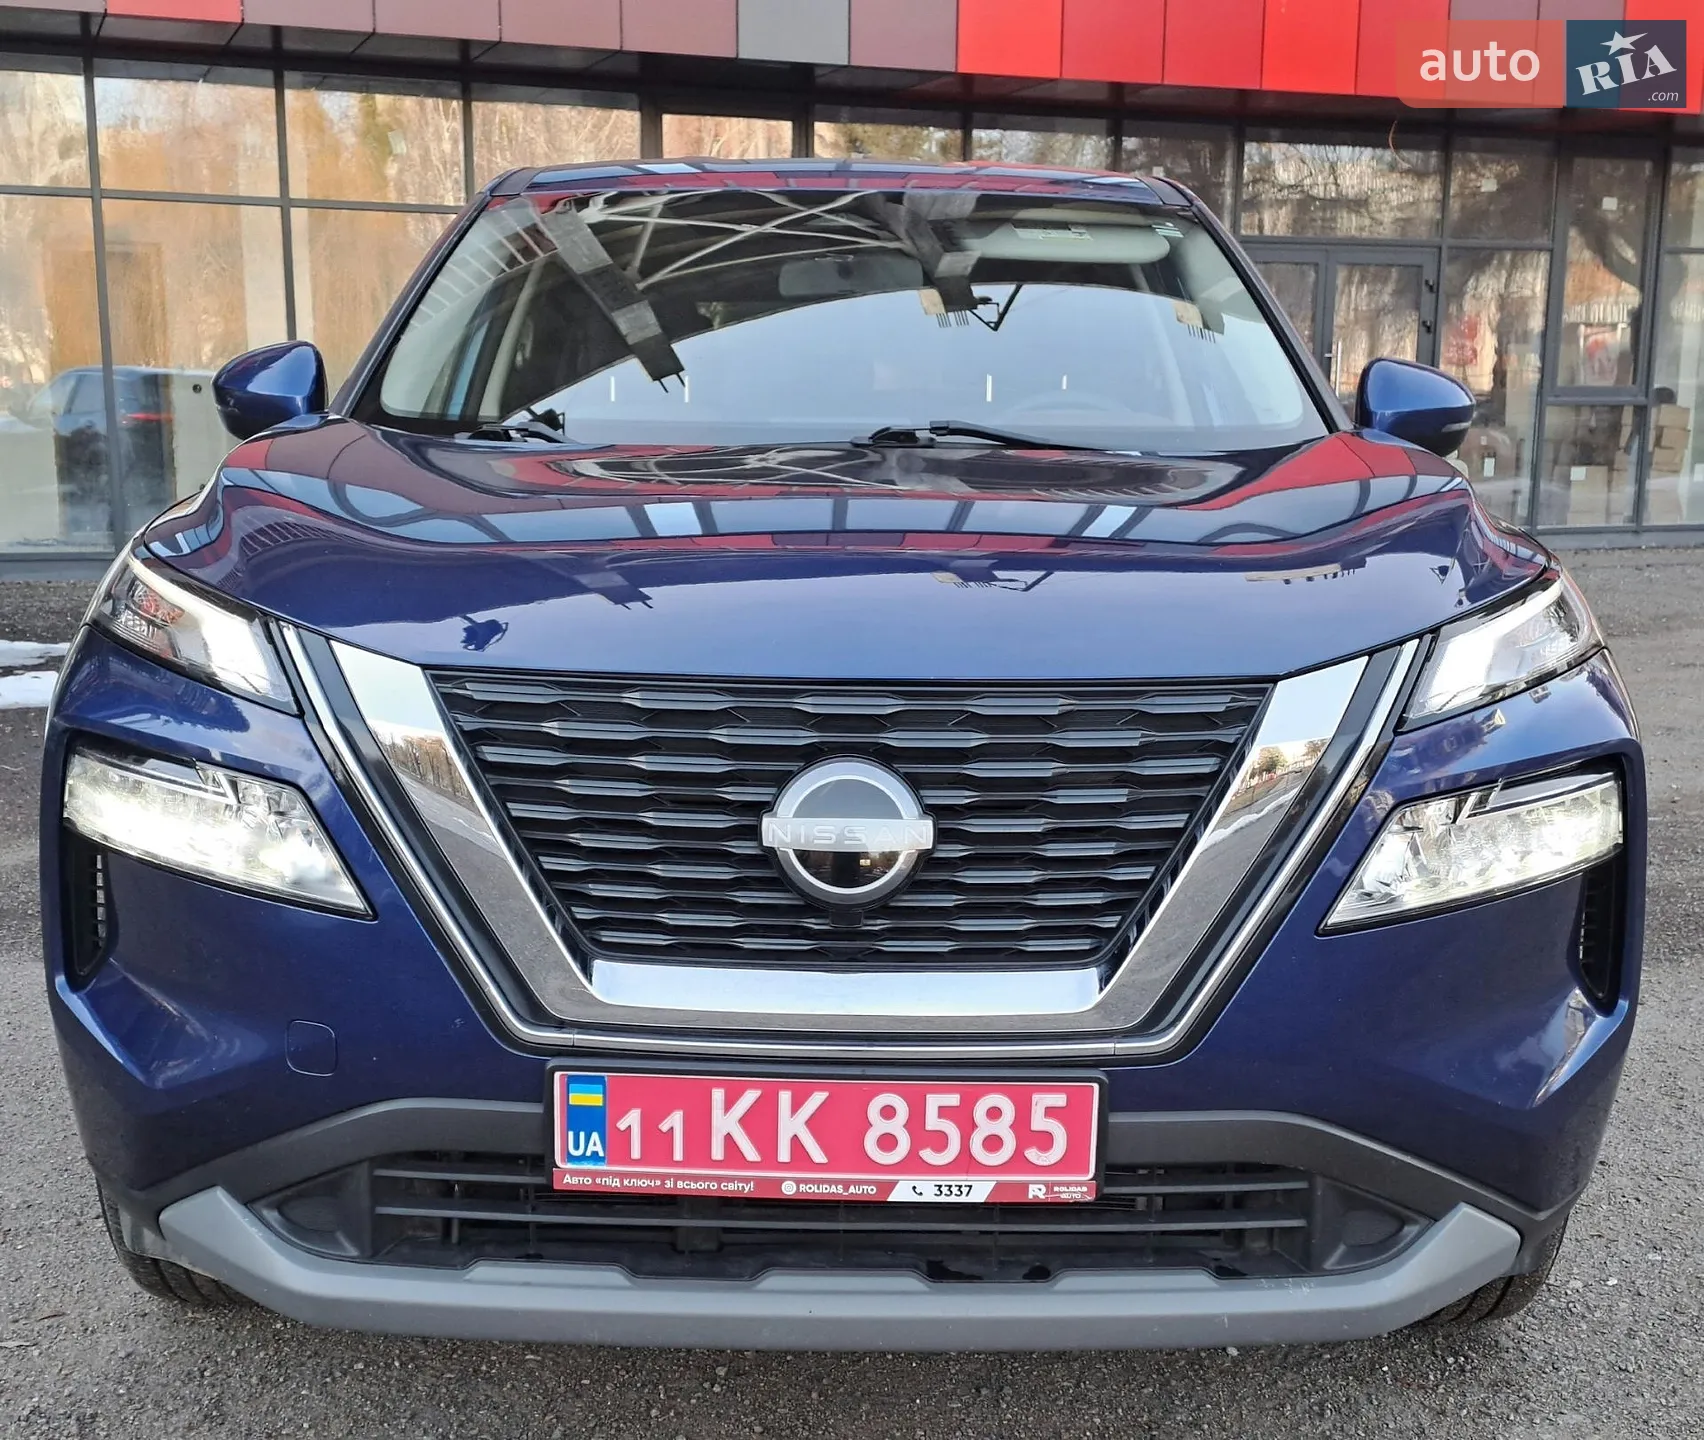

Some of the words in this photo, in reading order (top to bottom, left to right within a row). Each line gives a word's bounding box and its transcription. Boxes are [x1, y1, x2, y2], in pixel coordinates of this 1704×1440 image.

[768, 822, 927, 845] NISSAN
[863, 1092, 1067, 1167] 8585
[568, 1131, 605, 1158] UA
[563, 1174, 592, 1185] Авто
[595, 1176, 621, 1188] «під
[623, 1178, 661, 1189] ключ»
[664, 1178, 674, 1189] зі
[677, 1181, 718, 1191] всього
[720, 1180, 754, 1194] світу!
[799, 1183, 877, 1196] ROLIDAS_AUTO
[933, 1184, 973, 1197] 3337
